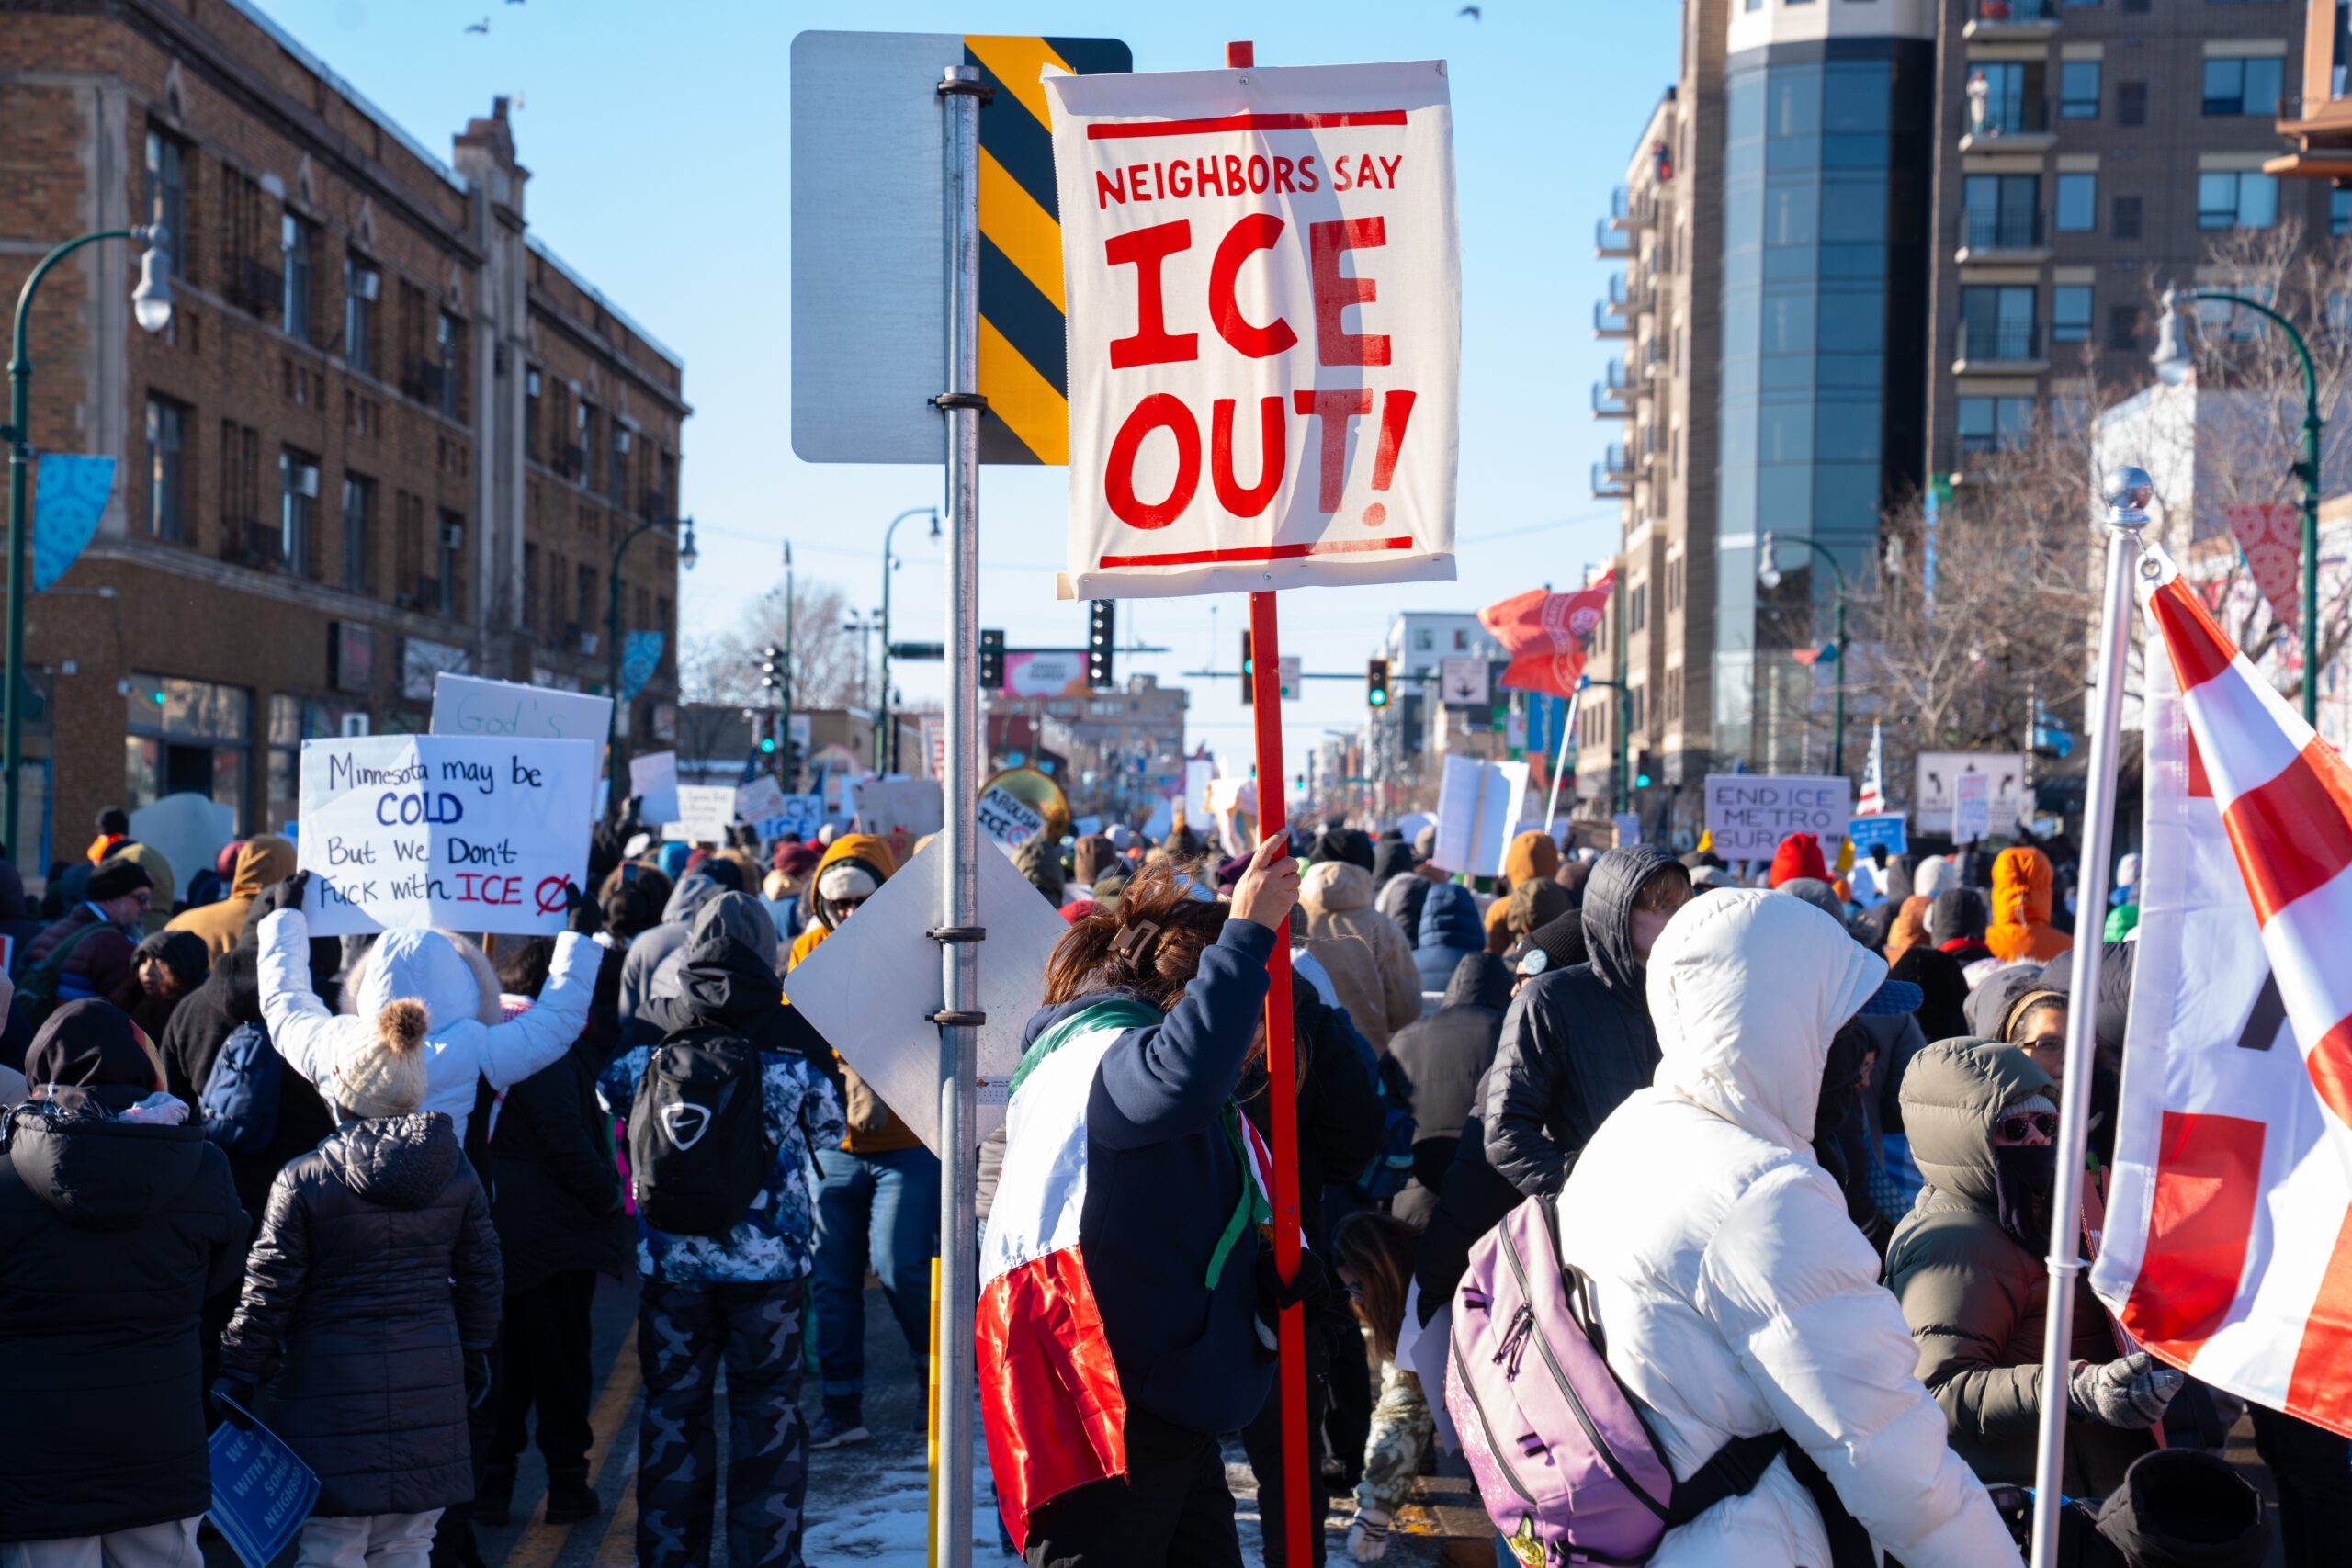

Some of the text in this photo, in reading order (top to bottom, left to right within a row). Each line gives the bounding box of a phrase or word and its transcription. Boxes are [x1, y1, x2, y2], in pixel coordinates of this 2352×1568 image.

[1095, 153, 1403, 209] NEIGHBORS SAY
[1104, 212, 1392, 370] ICE
[1104, 388, 1417, 529] OUT!
[456, 691, 566, 738] God's
[329, 752, 542, 795] Minnesota may be
[376, 791, 464, 827] COLD
[1715, 786, 1836, 809] END ICE
[978, 806, 1012, 839] ICE
[1724, 808, 1832, 829] METRO
[327, 835, 518, 866] But We Don't
[390, 873, 452, 900] with
[456, 874, 523, 906] ICE
[226, 1437, 249, 1463] WE
[233, 1458, 266, 1497] WITH
